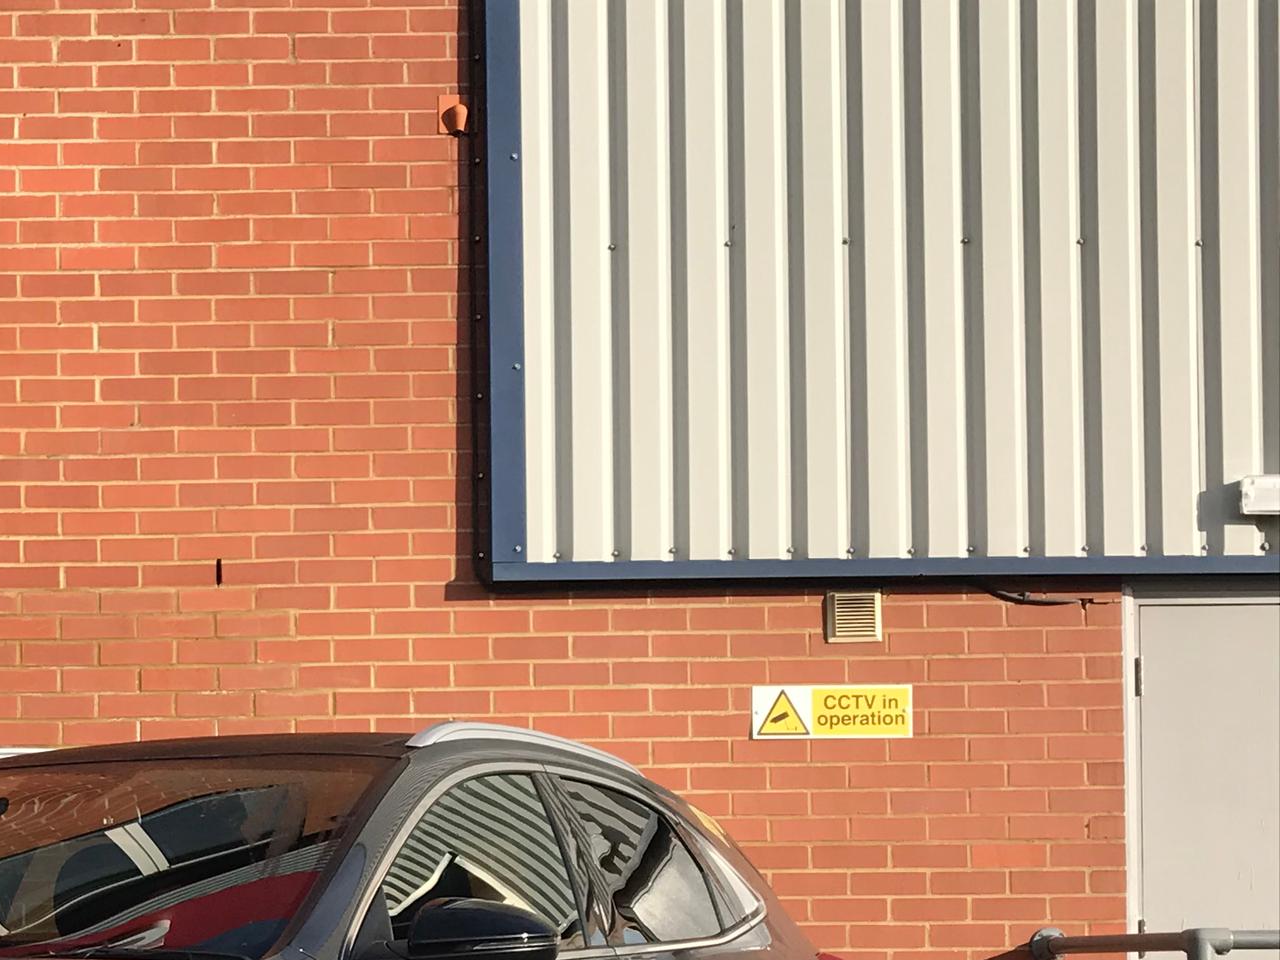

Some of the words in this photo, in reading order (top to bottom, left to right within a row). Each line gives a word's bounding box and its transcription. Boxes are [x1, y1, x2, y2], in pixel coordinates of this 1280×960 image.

[823, 694, 877, 711] CCTV
[882, 693, 899, 710] in
[817, 710, 906, 730] operation
